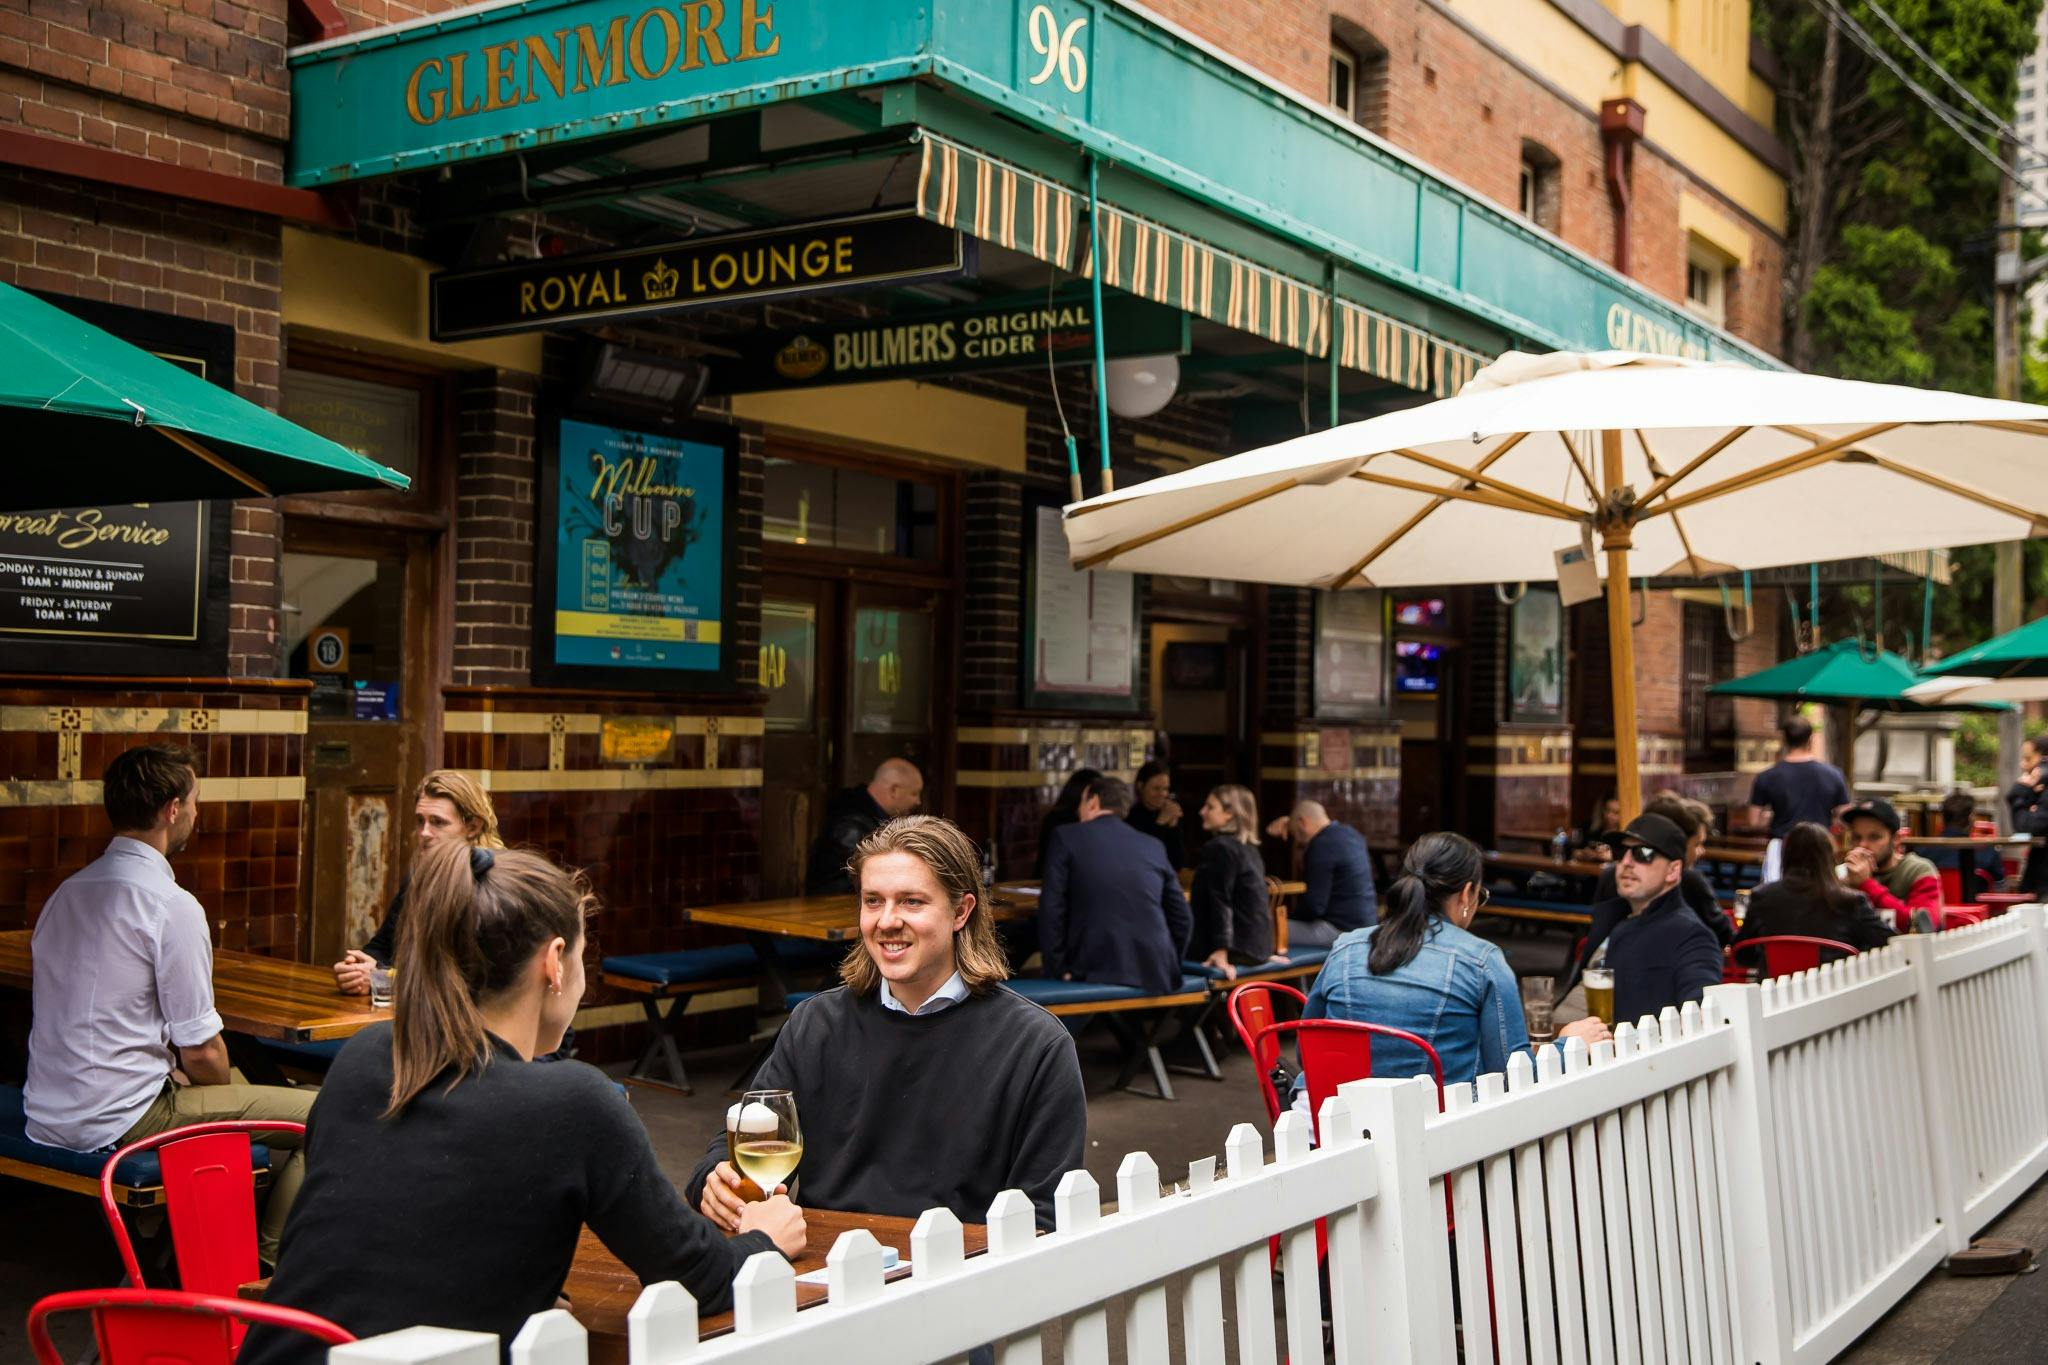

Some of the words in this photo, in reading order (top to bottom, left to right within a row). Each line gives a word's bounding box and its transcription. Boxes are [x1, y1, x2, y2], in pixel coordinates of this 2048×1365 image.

[405, 0, 780, 125] GLENMORE
[1028, 4, 1088, 94] 96
[520, 268, 627, 315] ROYAL
[692, 236, 853, 294] LOUNGE
[963, 306, 1090, 337] ORIGINAL
[834, 321, 956, 371] BULMERS
[964, 334, 1035, 360] CIDER
[591, 454, 696, 503] Melbourne
[0, 511, 69, 536] reat
[57, 508, 170, 549] Service
[604, 493, 681, 542] CUP
[0, 561, 35, 574] ONDAY
[43, 565, 93, 578] THURSDAY
[106, 570, 144, 582] SUNDAY
[21, 576, 51, 587] 10AM
[62, 579, 114, 591] MIDNIGHT
[20, 596, 55, 608] FRIDAY
[64, 599, 112, 611] SATURDAY
[35, 609, 65, 620] 10AM
[76, 611, 99, 622] 1AM
[759, 643, 785, 688] BAR
